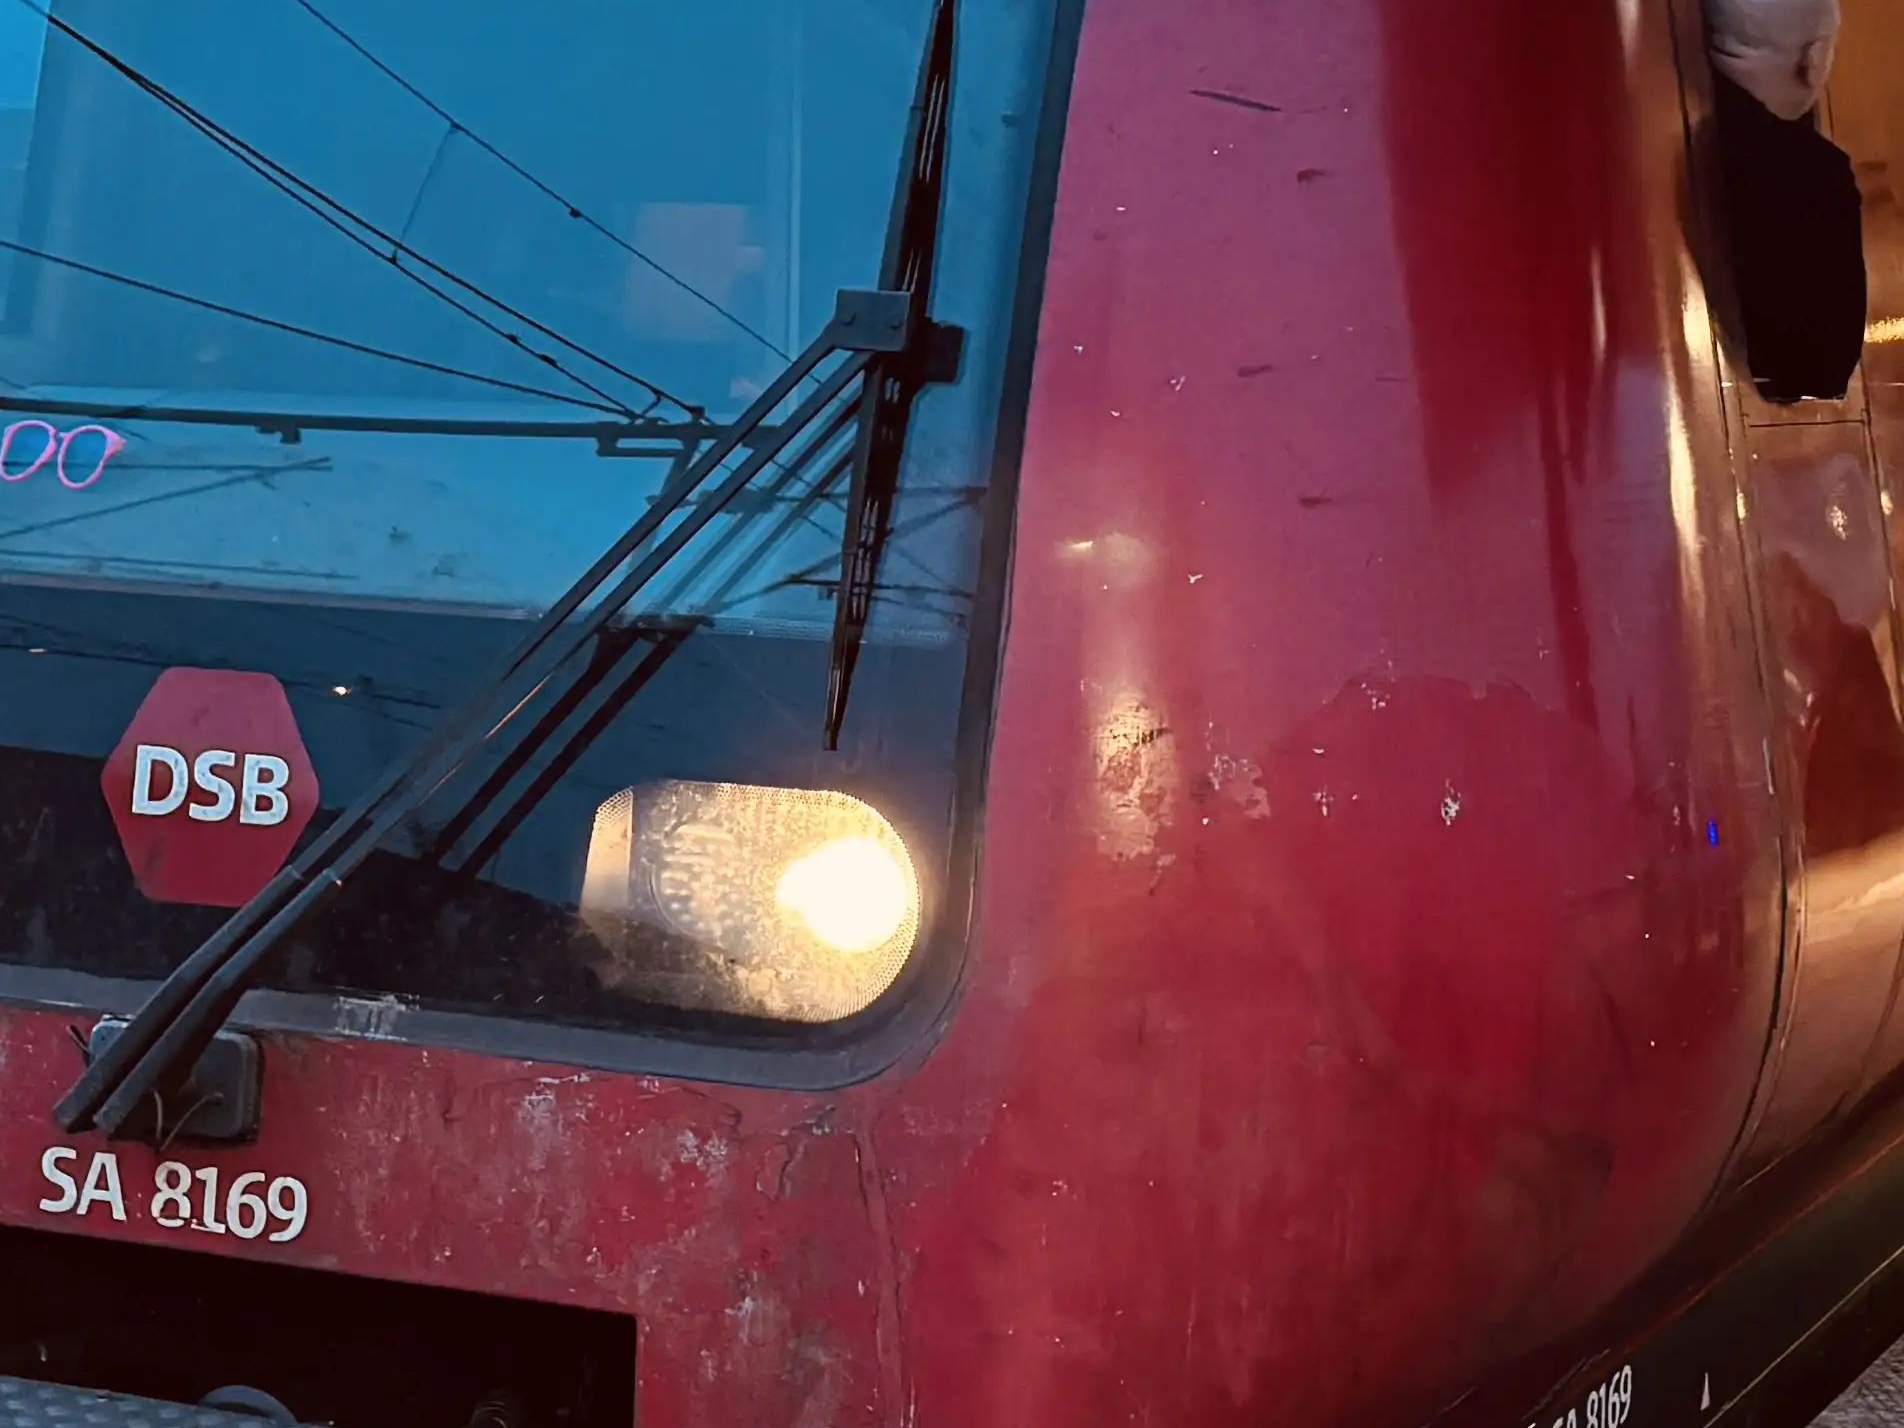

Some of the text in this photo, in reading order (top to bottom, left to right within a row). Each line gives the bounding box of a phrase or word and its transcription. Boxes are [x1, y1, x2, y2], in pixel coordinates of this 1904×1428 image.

[132, 745, 290, 825] DSB
[40, 1147, 308, 1242] SA 8169
